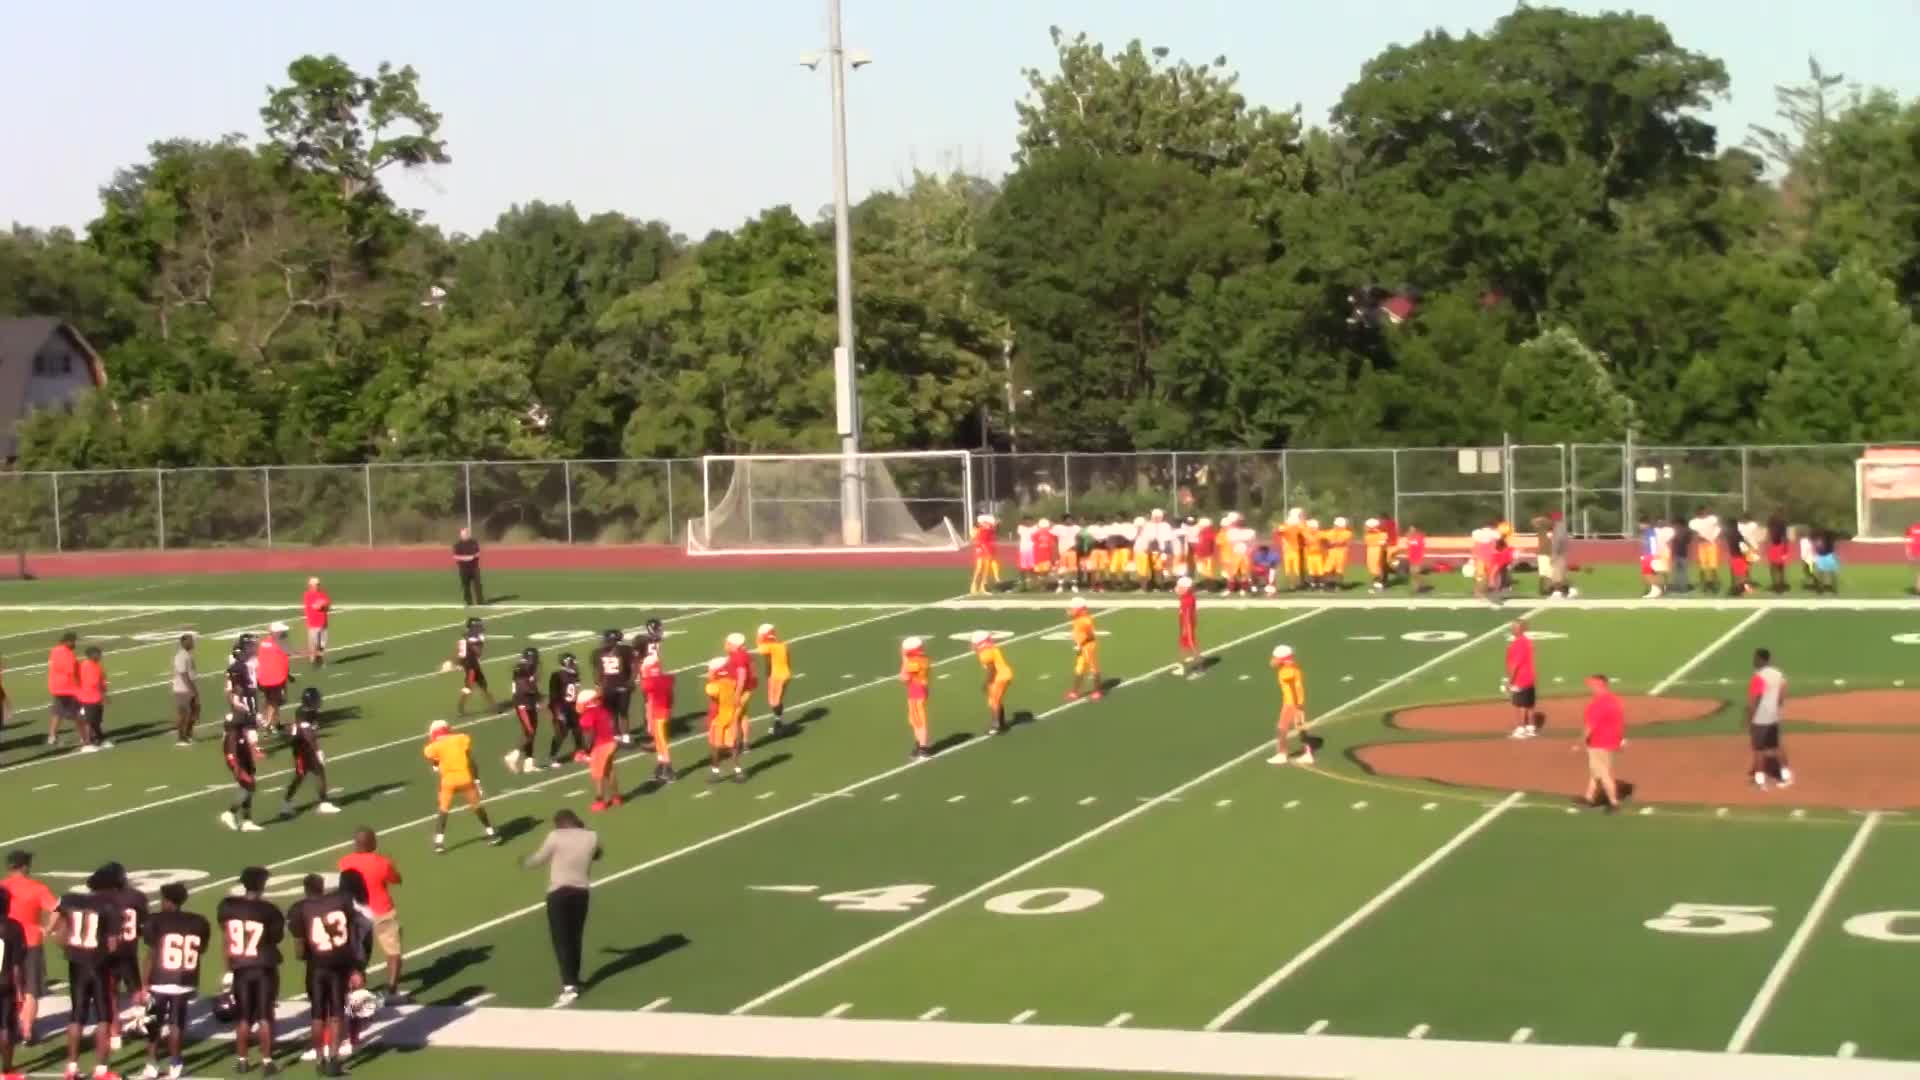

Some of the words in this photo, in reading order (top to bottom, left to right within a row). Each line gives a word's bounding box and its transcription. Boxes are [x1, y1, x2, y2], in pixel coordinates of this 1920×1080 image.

[68, 911, 99, 949] 11
[226, 919, 264, 957] 97
[311, 910, 349, 952] 43
[161, 932, 201, 970] 66
